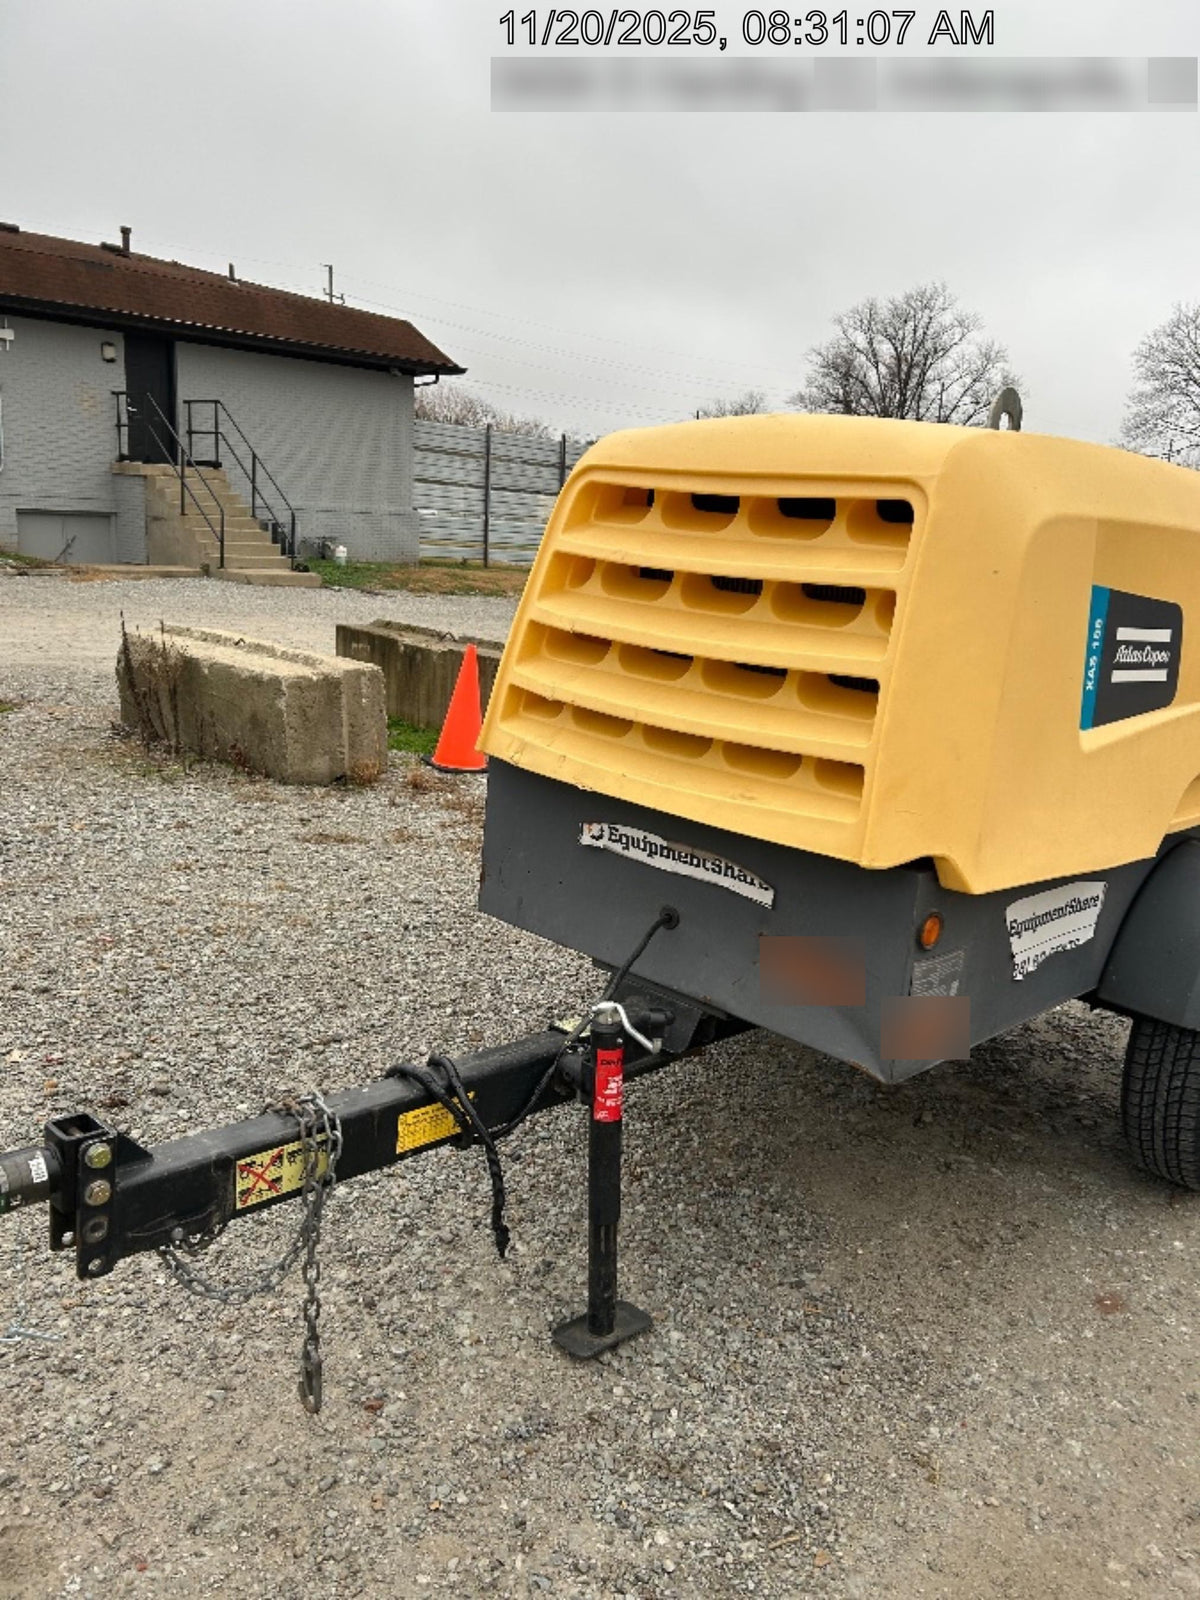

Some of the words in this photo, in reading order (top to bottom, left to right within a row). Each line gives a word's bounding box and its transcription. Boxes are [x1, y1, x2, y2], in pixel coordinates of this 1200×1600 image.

[1086, 655, 1098, 690] XAS
[1113, 644, 1142, 664] Atlas
[1142, 644, 1171, 667] Copco
[607, 825, 770, 892] EquipmentSha
